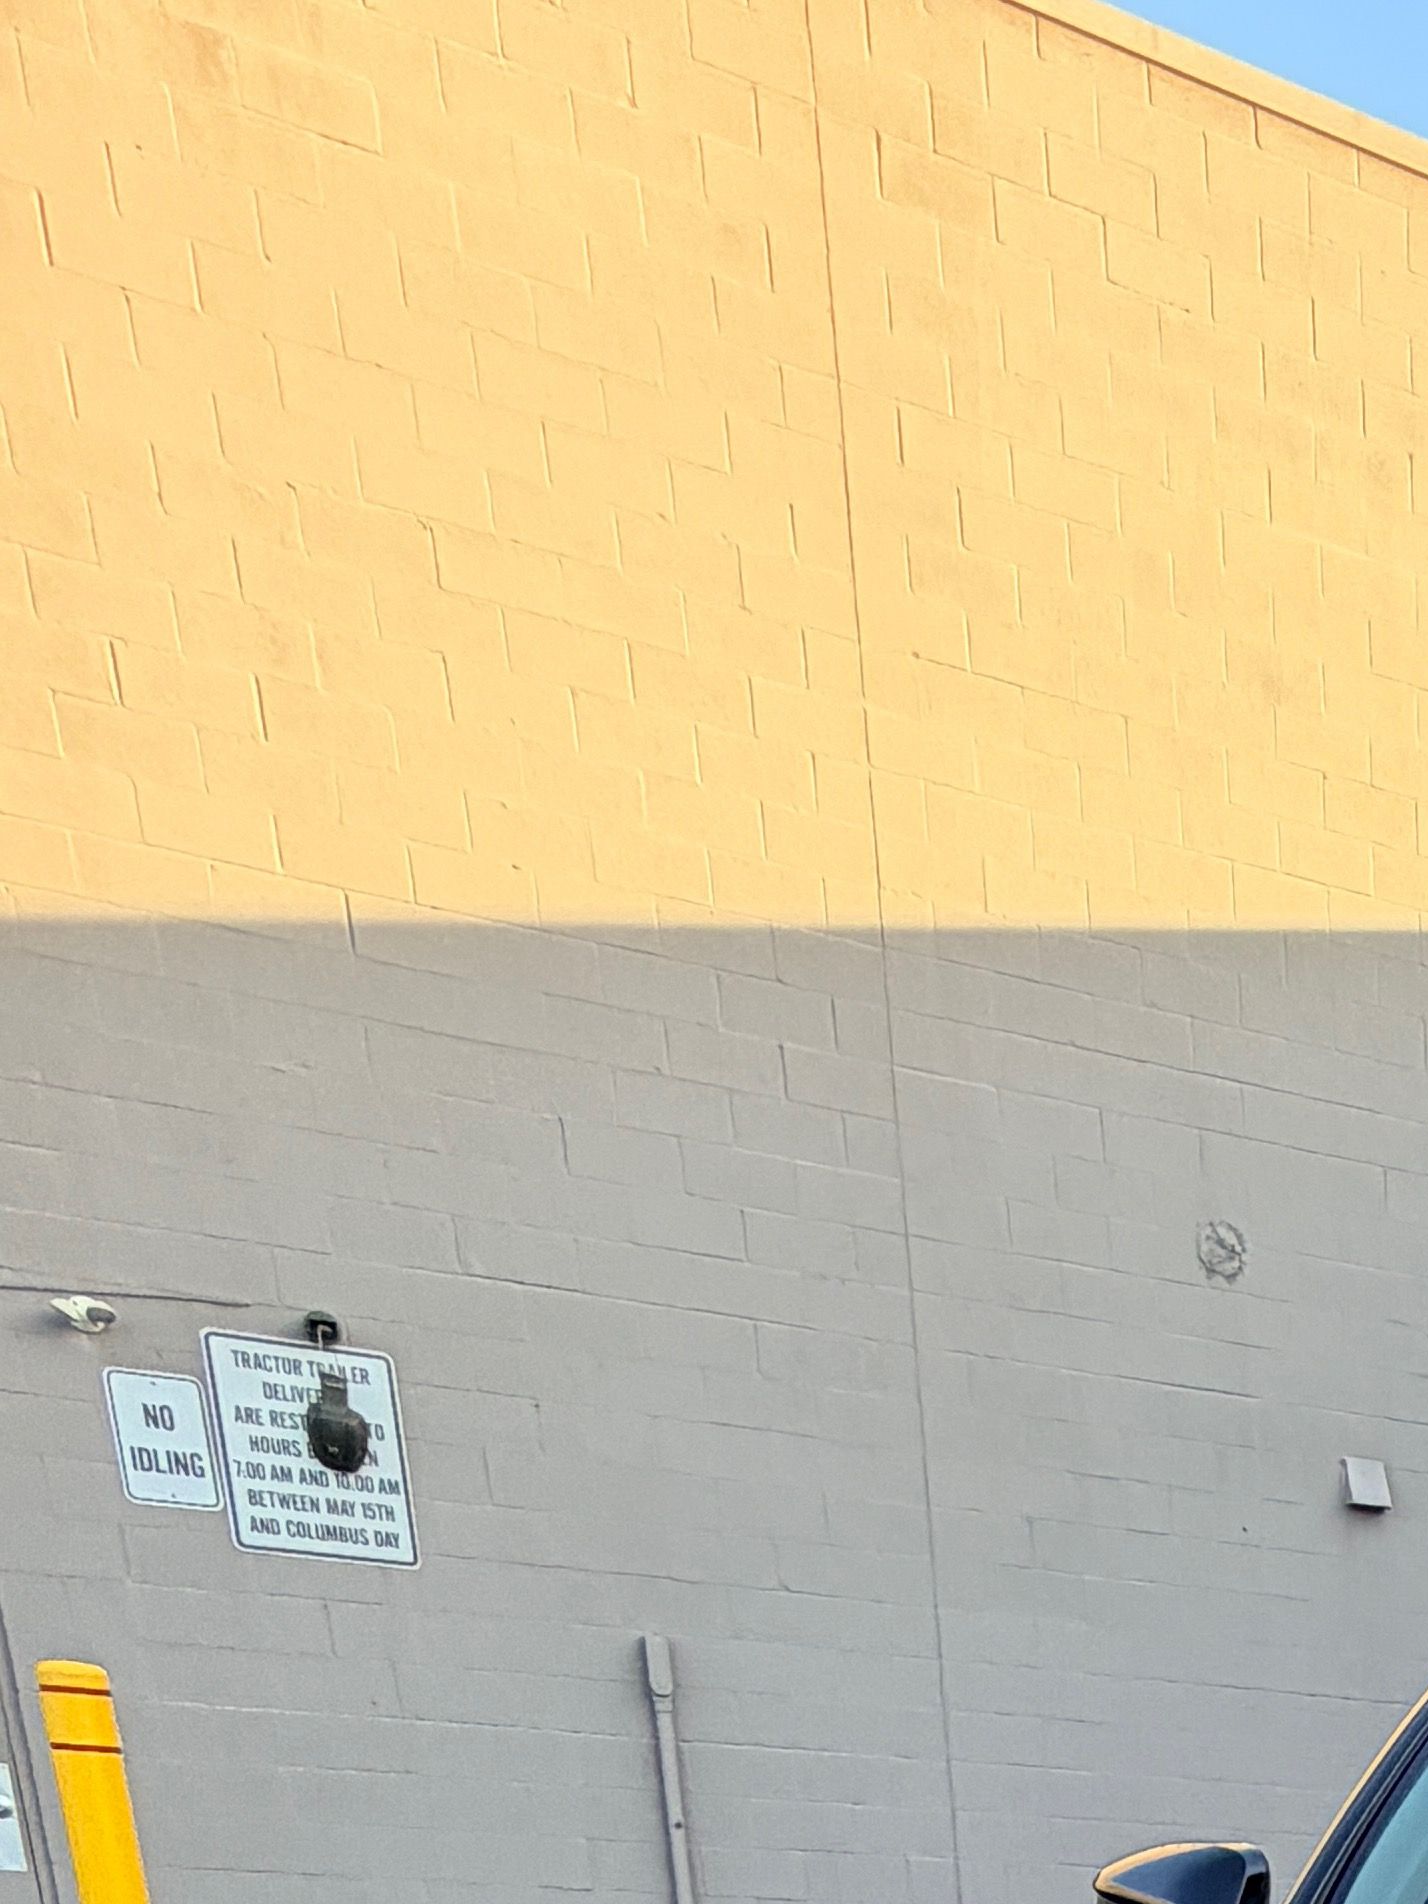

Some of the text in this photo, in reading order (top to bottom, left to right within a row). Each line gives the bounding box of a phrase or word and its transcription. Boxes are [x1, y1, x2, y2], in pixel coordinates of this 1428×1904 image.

[230, 1350, 303, 1377] TRACTOR
[141, 1402, 175, 1431] NO
[234, 1405, 264, 1427] ARE
[130, 1445, 205, 1478] IDLING
[249, 1434, 303, 1458] HOURS
[232, 1458, 266, 1480] 7:00
[270, 1464, 294, 1483] AM
[299, 1467, 330, 1488] AND
[378, 1477, 401, 1496] AM
[247, 1488, 396, 1522] BETWEEN MAY 15TH
[250, 1515, 400, 1549] AND COLUMBUS DAY
